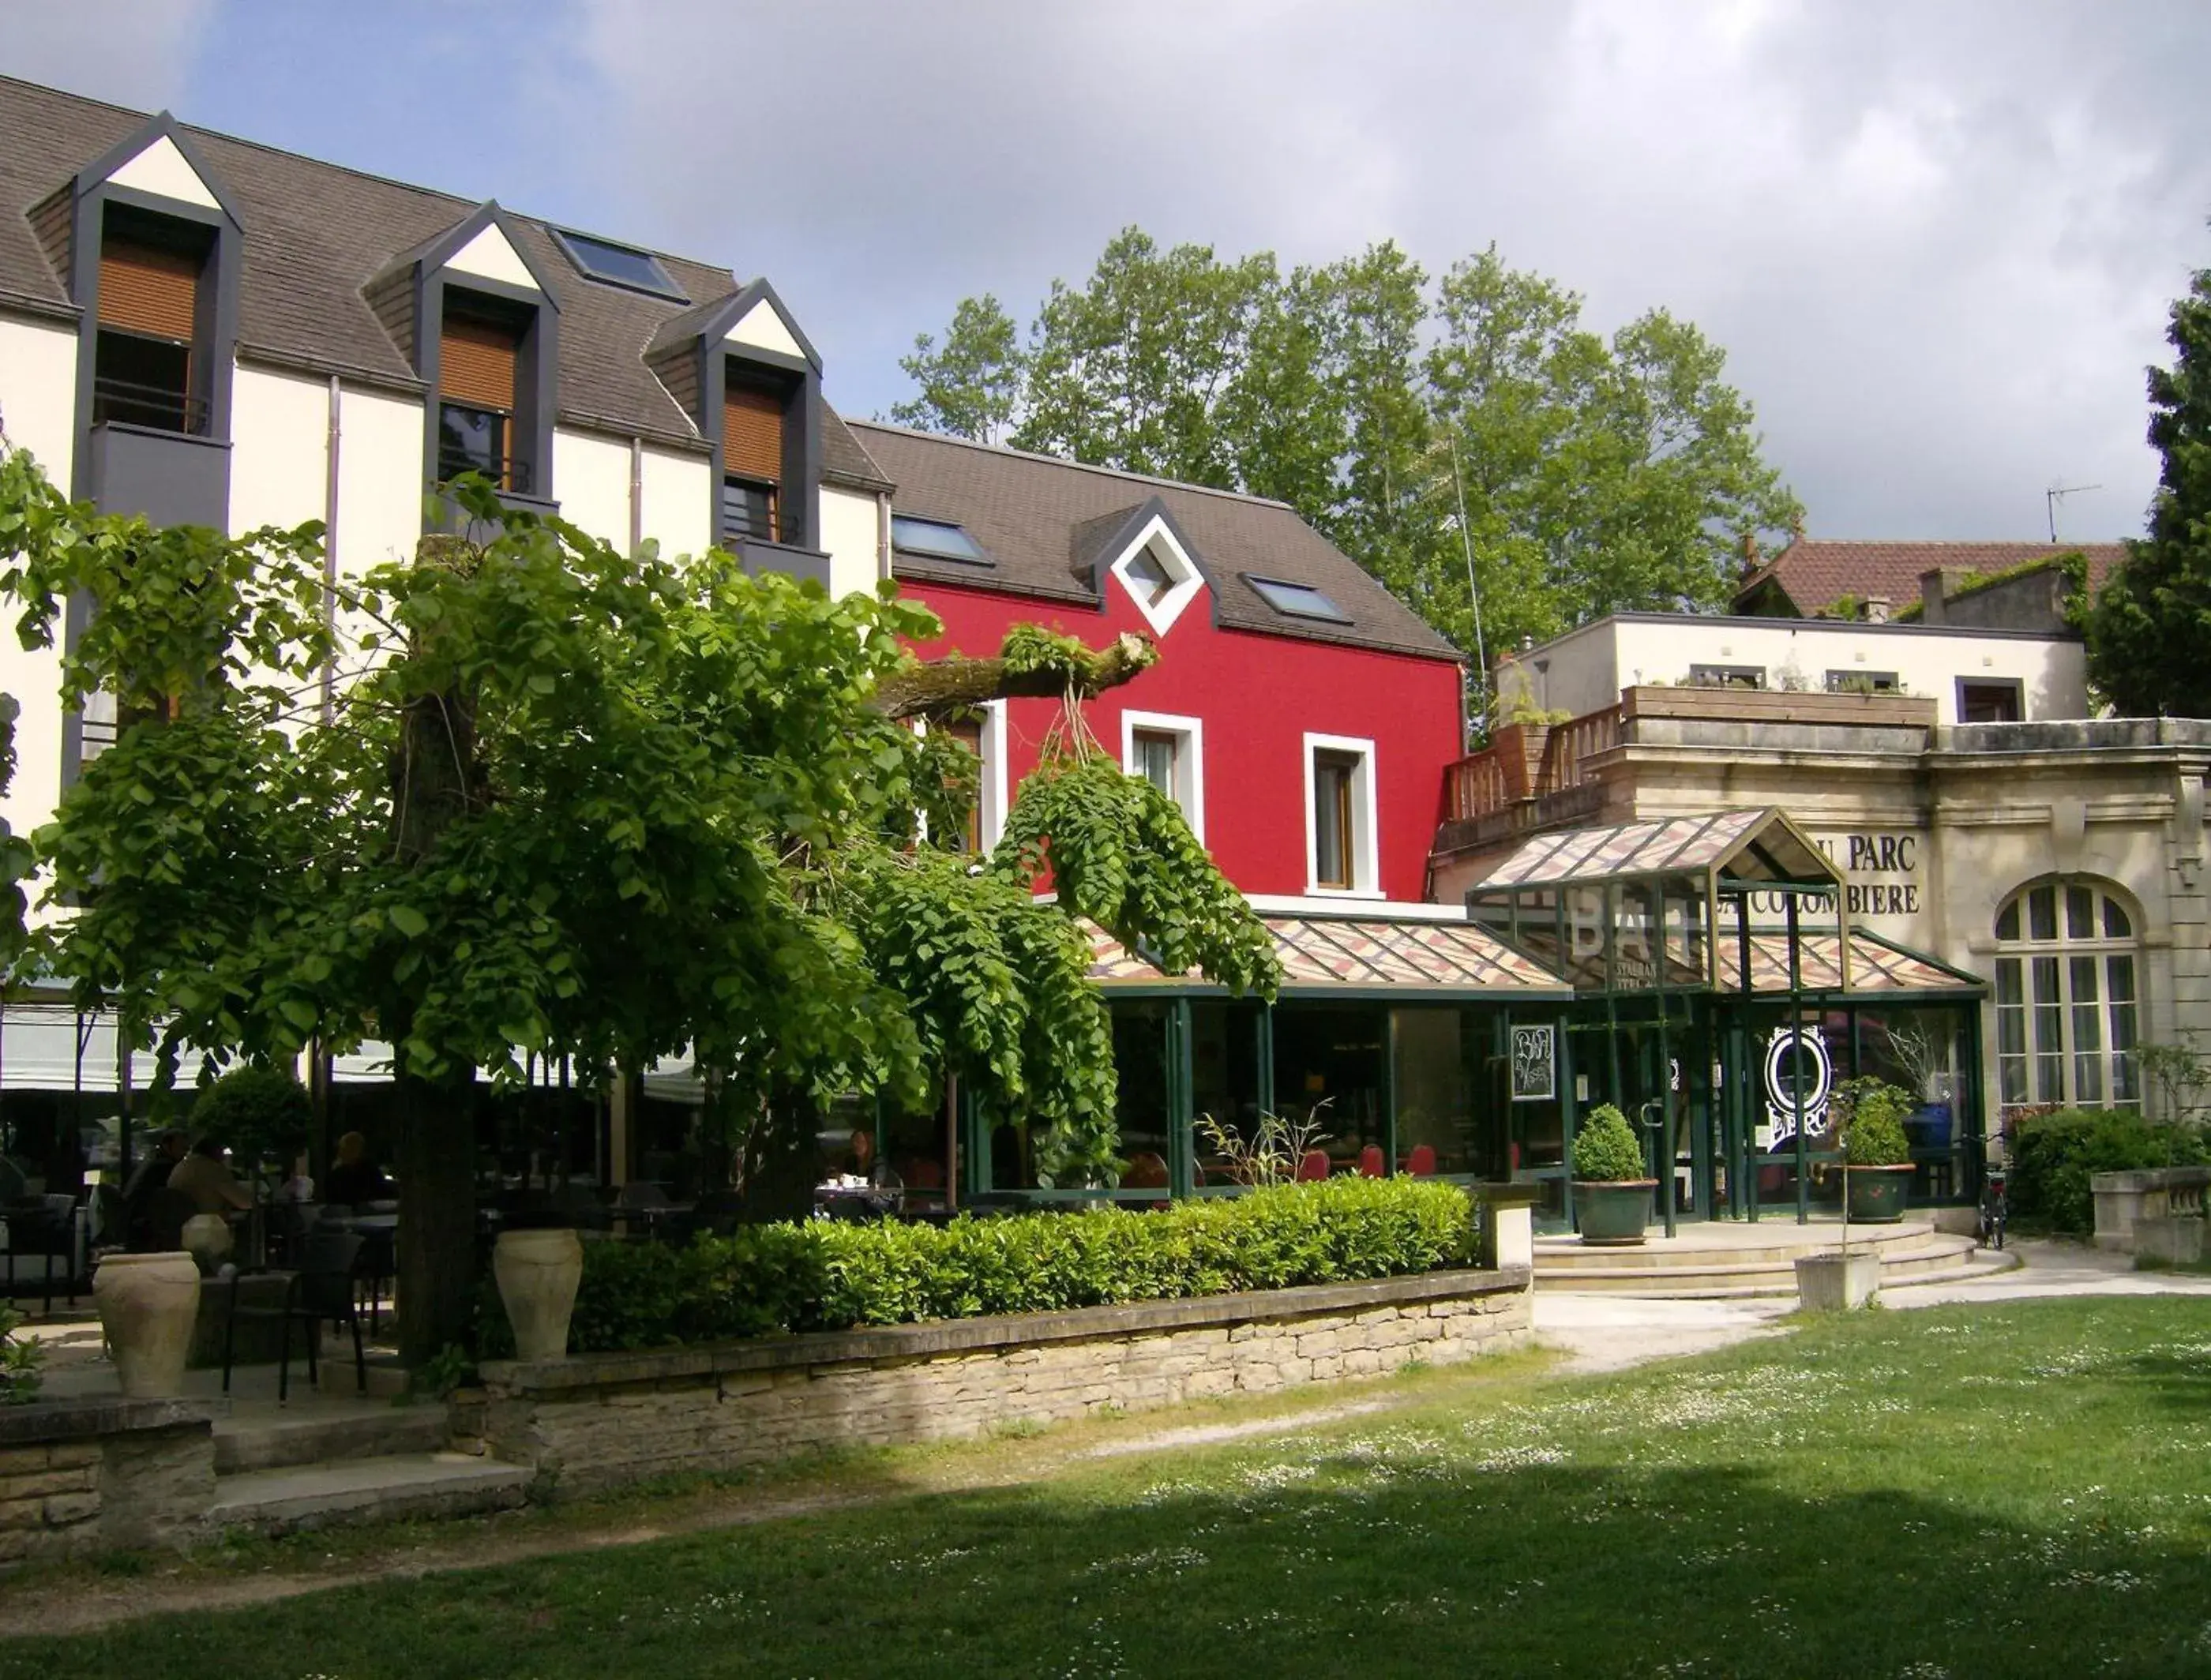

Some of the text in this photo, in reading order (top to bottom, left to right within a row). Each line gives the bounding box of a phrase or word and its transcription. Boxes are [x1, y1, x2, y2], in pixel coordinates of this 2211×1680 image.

[1848, 834, 1916, 872] PARC
[1751, 885, 1920, 913] COOMBIERE
[1784, 1102, 1830, 1138] PRC
